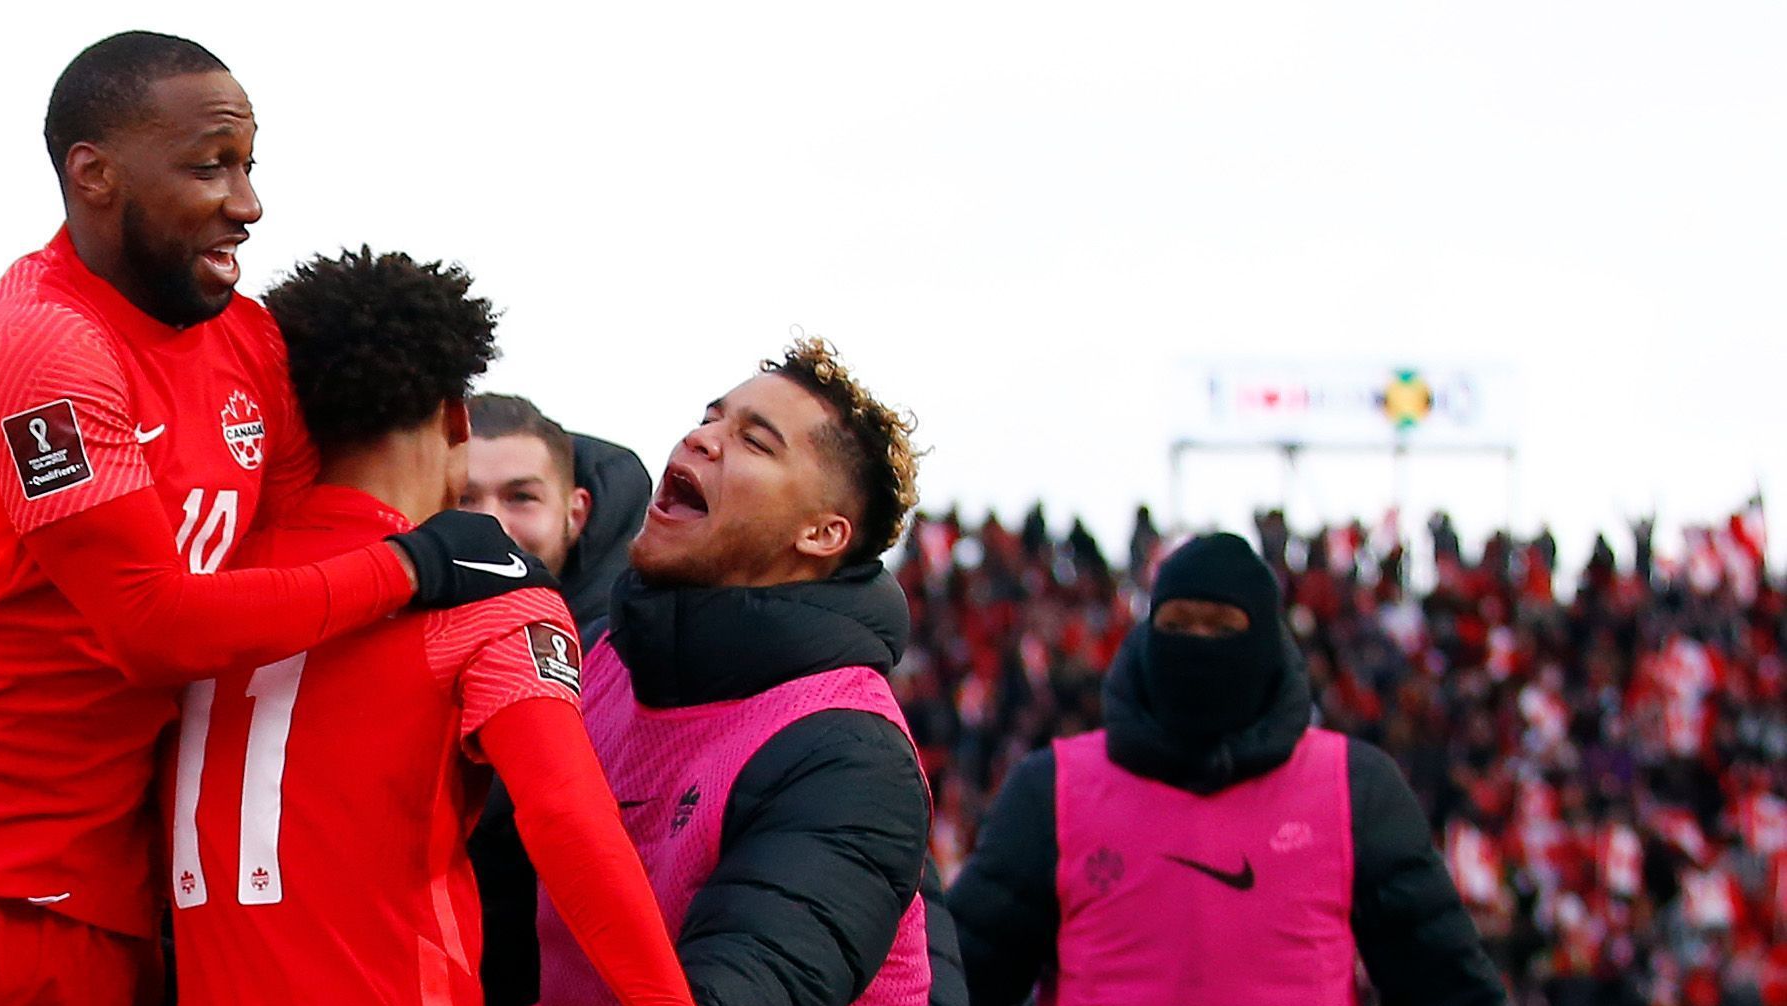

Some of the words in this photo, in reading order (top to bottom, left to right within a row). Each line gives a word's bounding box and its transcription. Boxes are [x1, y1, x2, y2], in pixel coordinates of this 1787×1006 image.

[225, 424, 265, 440] CANADA
[32, 465, 77, 486] Qualifiers
[175, 487, 239, 575] 10
[172, 651, 307, 909] 11
